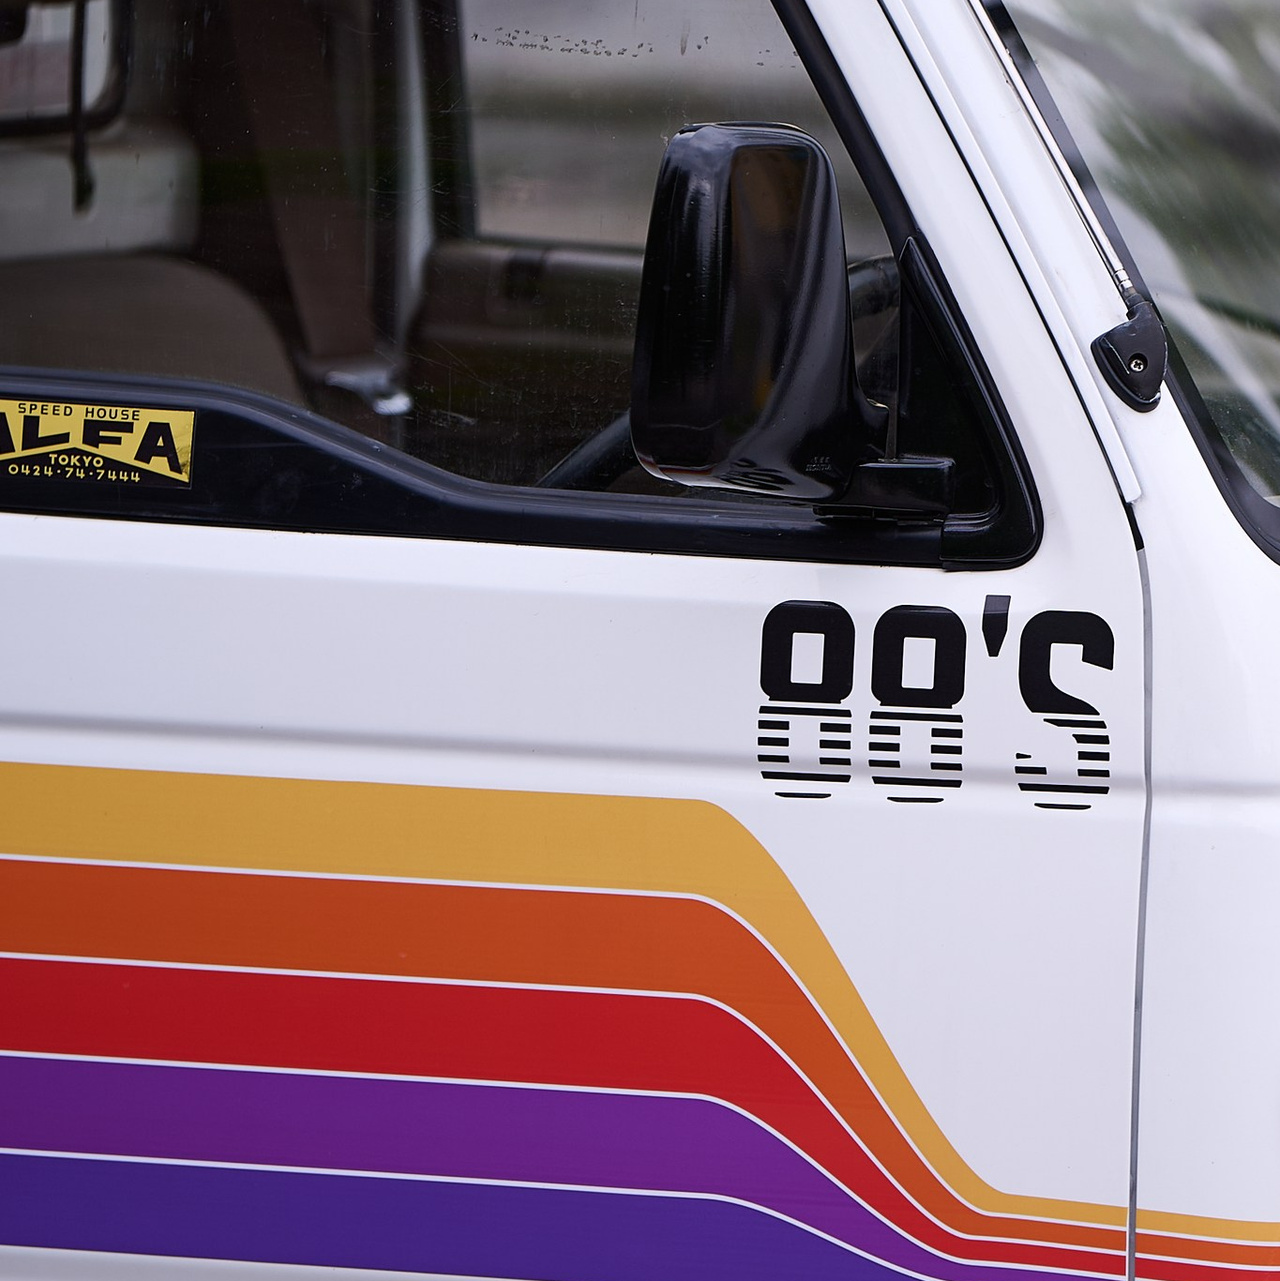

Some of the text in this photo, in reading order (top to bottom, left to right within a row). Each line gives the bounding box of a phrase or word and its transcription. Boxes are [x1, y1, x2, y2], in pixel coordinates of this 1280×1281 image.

[18, 402, 140, 421] SPEED HOUSE
[49, 453, 104, 468] TOKYO
